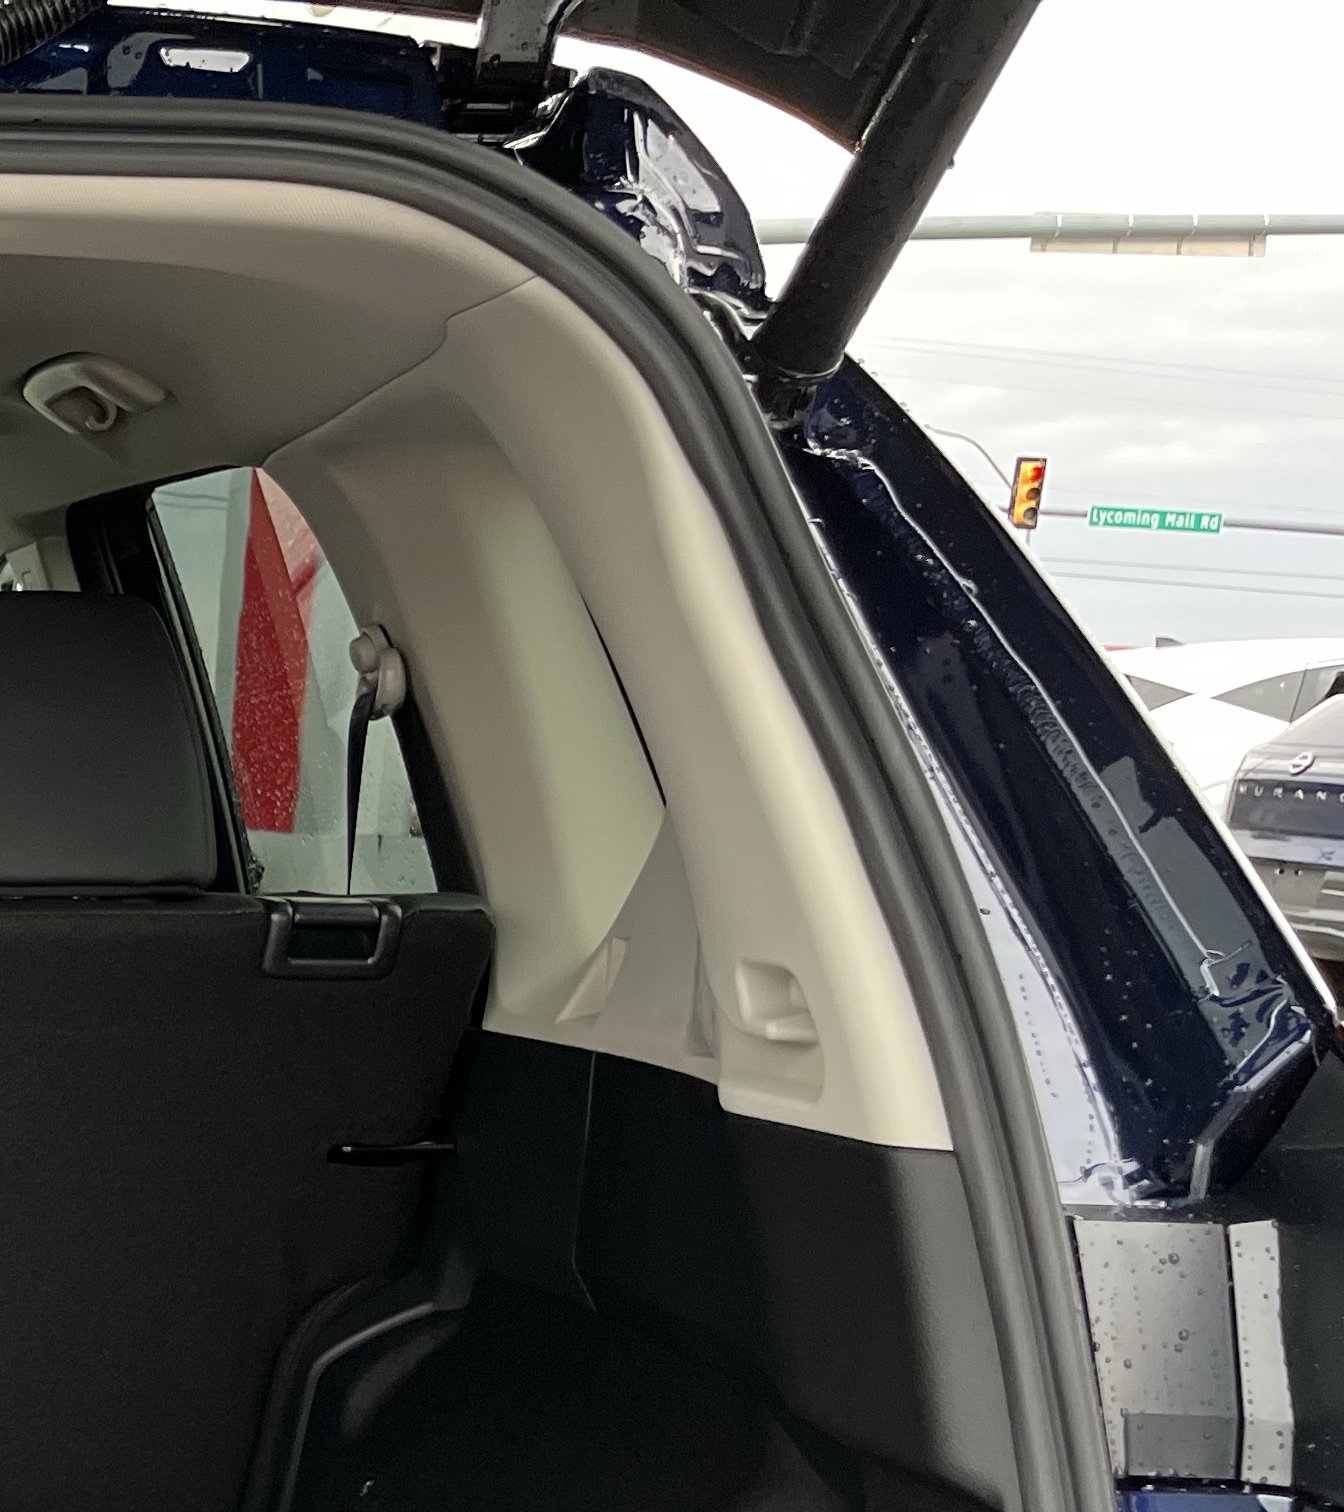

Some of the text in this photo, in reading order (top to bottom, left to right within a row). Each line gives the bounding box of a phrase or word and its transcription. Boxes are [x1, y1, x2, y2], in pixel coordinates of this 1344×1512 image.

[1092, 508, 1219, 530] Lycoming Mall Rd
